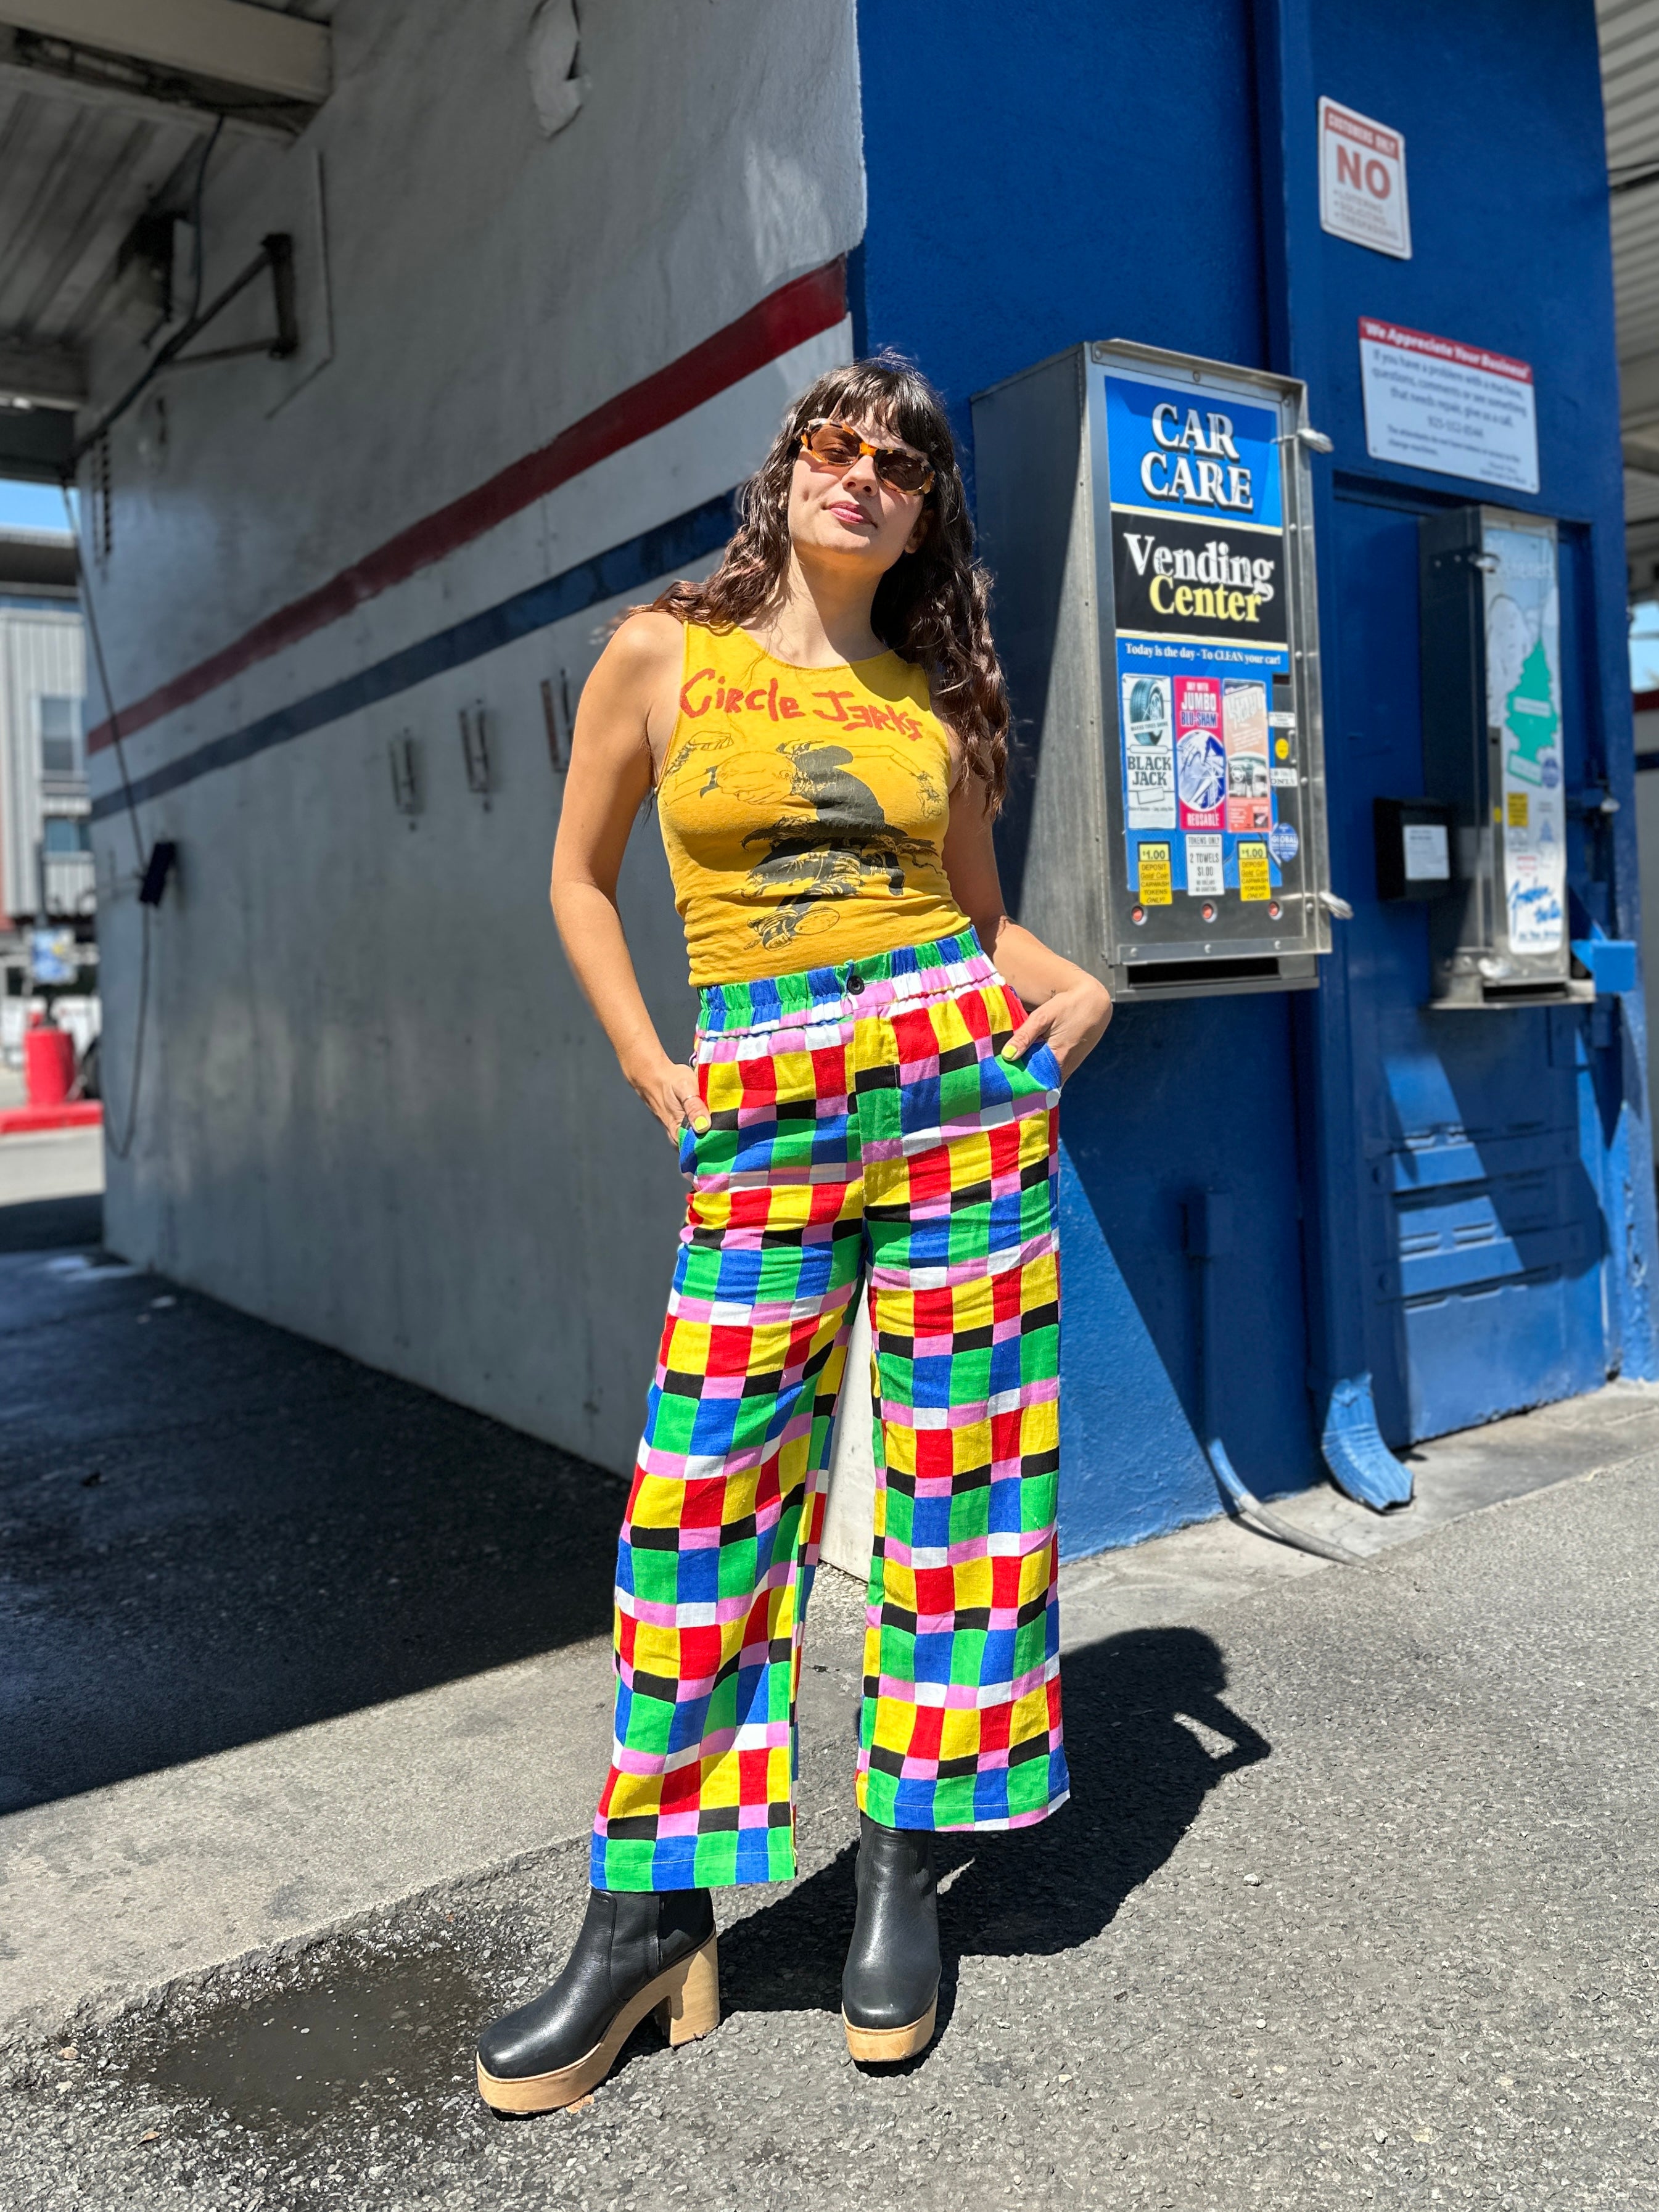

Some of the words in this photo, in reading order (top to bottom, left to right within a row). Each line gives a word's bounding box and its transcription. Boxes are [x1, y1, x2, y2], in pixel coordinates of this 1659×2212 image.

[1336, 144, 1391, 200] NO
[1365, 322, 1386, 338] We
[1386, 328, 1453, 357] Appreciate
[1454, 347, 1480, 364] Your
[1151, 403, 1240, 461] CAR
[1140, 451, 1254, 512] CARE
[1123, 532, 1275, 602] Vending
[1149, 574, 1262, 622] Center
[1126, 643, 1153, 659] Today
[1155, 646, 1162, 656] is
[1164, 646, 1179, 657] the
[1180, 647, 1195, 660] day
[1201, 649, 1213, 660] To
[1214, 650, 1243, 663] CLEAN
[1245, 654, 1263, 665] your
[1265, 655, 1281, 665] car!
[1181, 691, 1217, 712] JUMBO
[1181, 712, 1217, 728] BLU-SHAM
[1127, 756, 1172, 771] BLACK
[1132, 771, 1167, 786] JACK
[1187, 813, 1219, 826] REUSABLE
[1143, 850, 1165, 860] $1.00
[1190, 854, 1194, 863] 2
[1196, 853, 1219, 863] TOWELS
[1242, 849, 1263, 858] $1.00
[1198, 866, 1213, 876] $1.00
